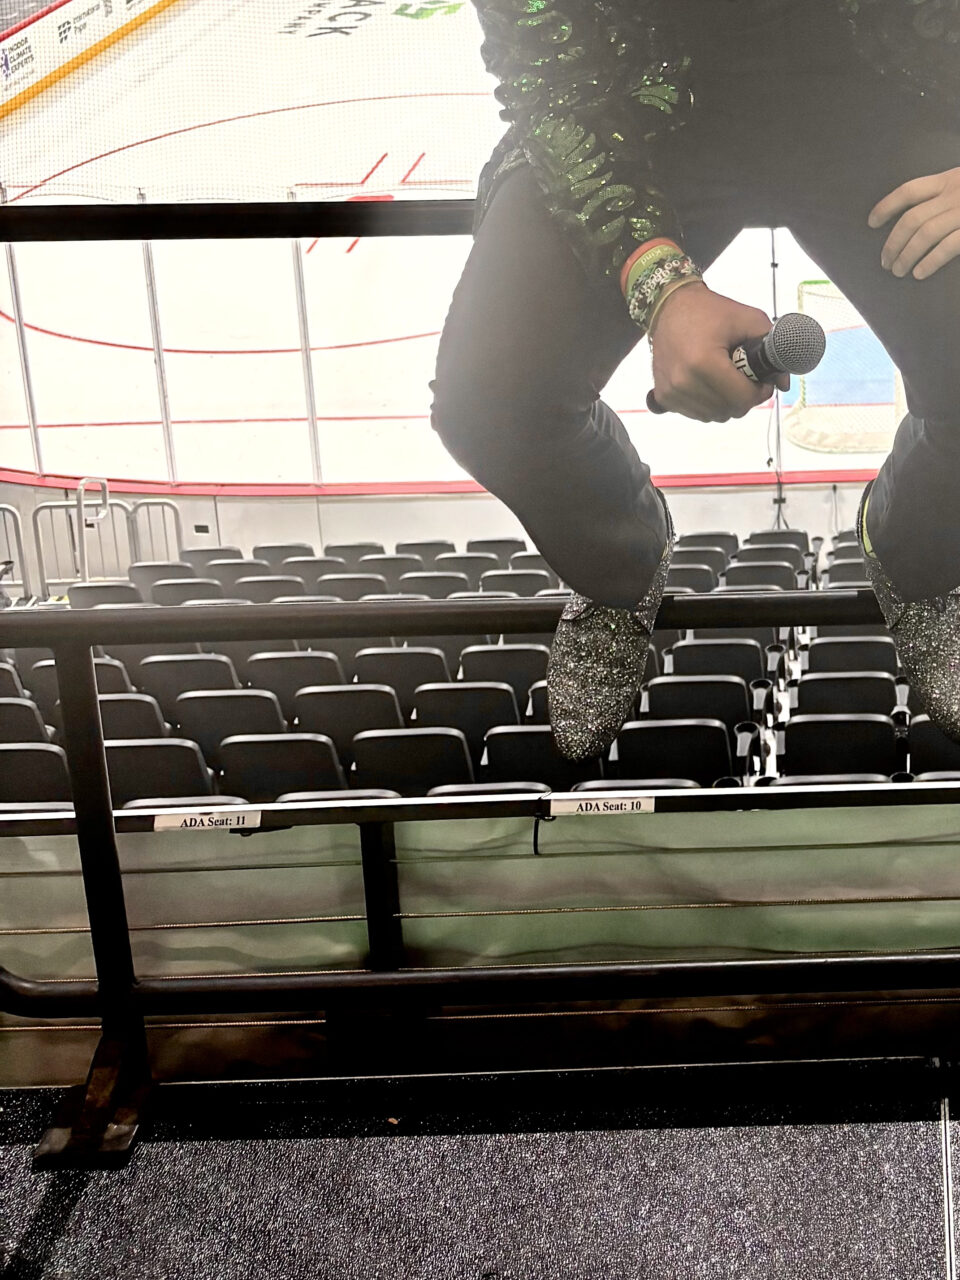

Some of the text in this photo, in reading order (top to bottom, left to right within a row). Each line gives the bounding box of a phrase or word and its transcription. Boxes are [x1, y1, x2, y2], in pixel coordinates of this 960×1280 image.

[8, 36, 29, 55] INDOOR
[9, 45, 32, 64] CLIMATE
[11, 54, 35, 75] EXPERTS
[576, 799, 642, 813] ADA Seat: 10
[180, 814, 246, 829] ADA Seat: 11
